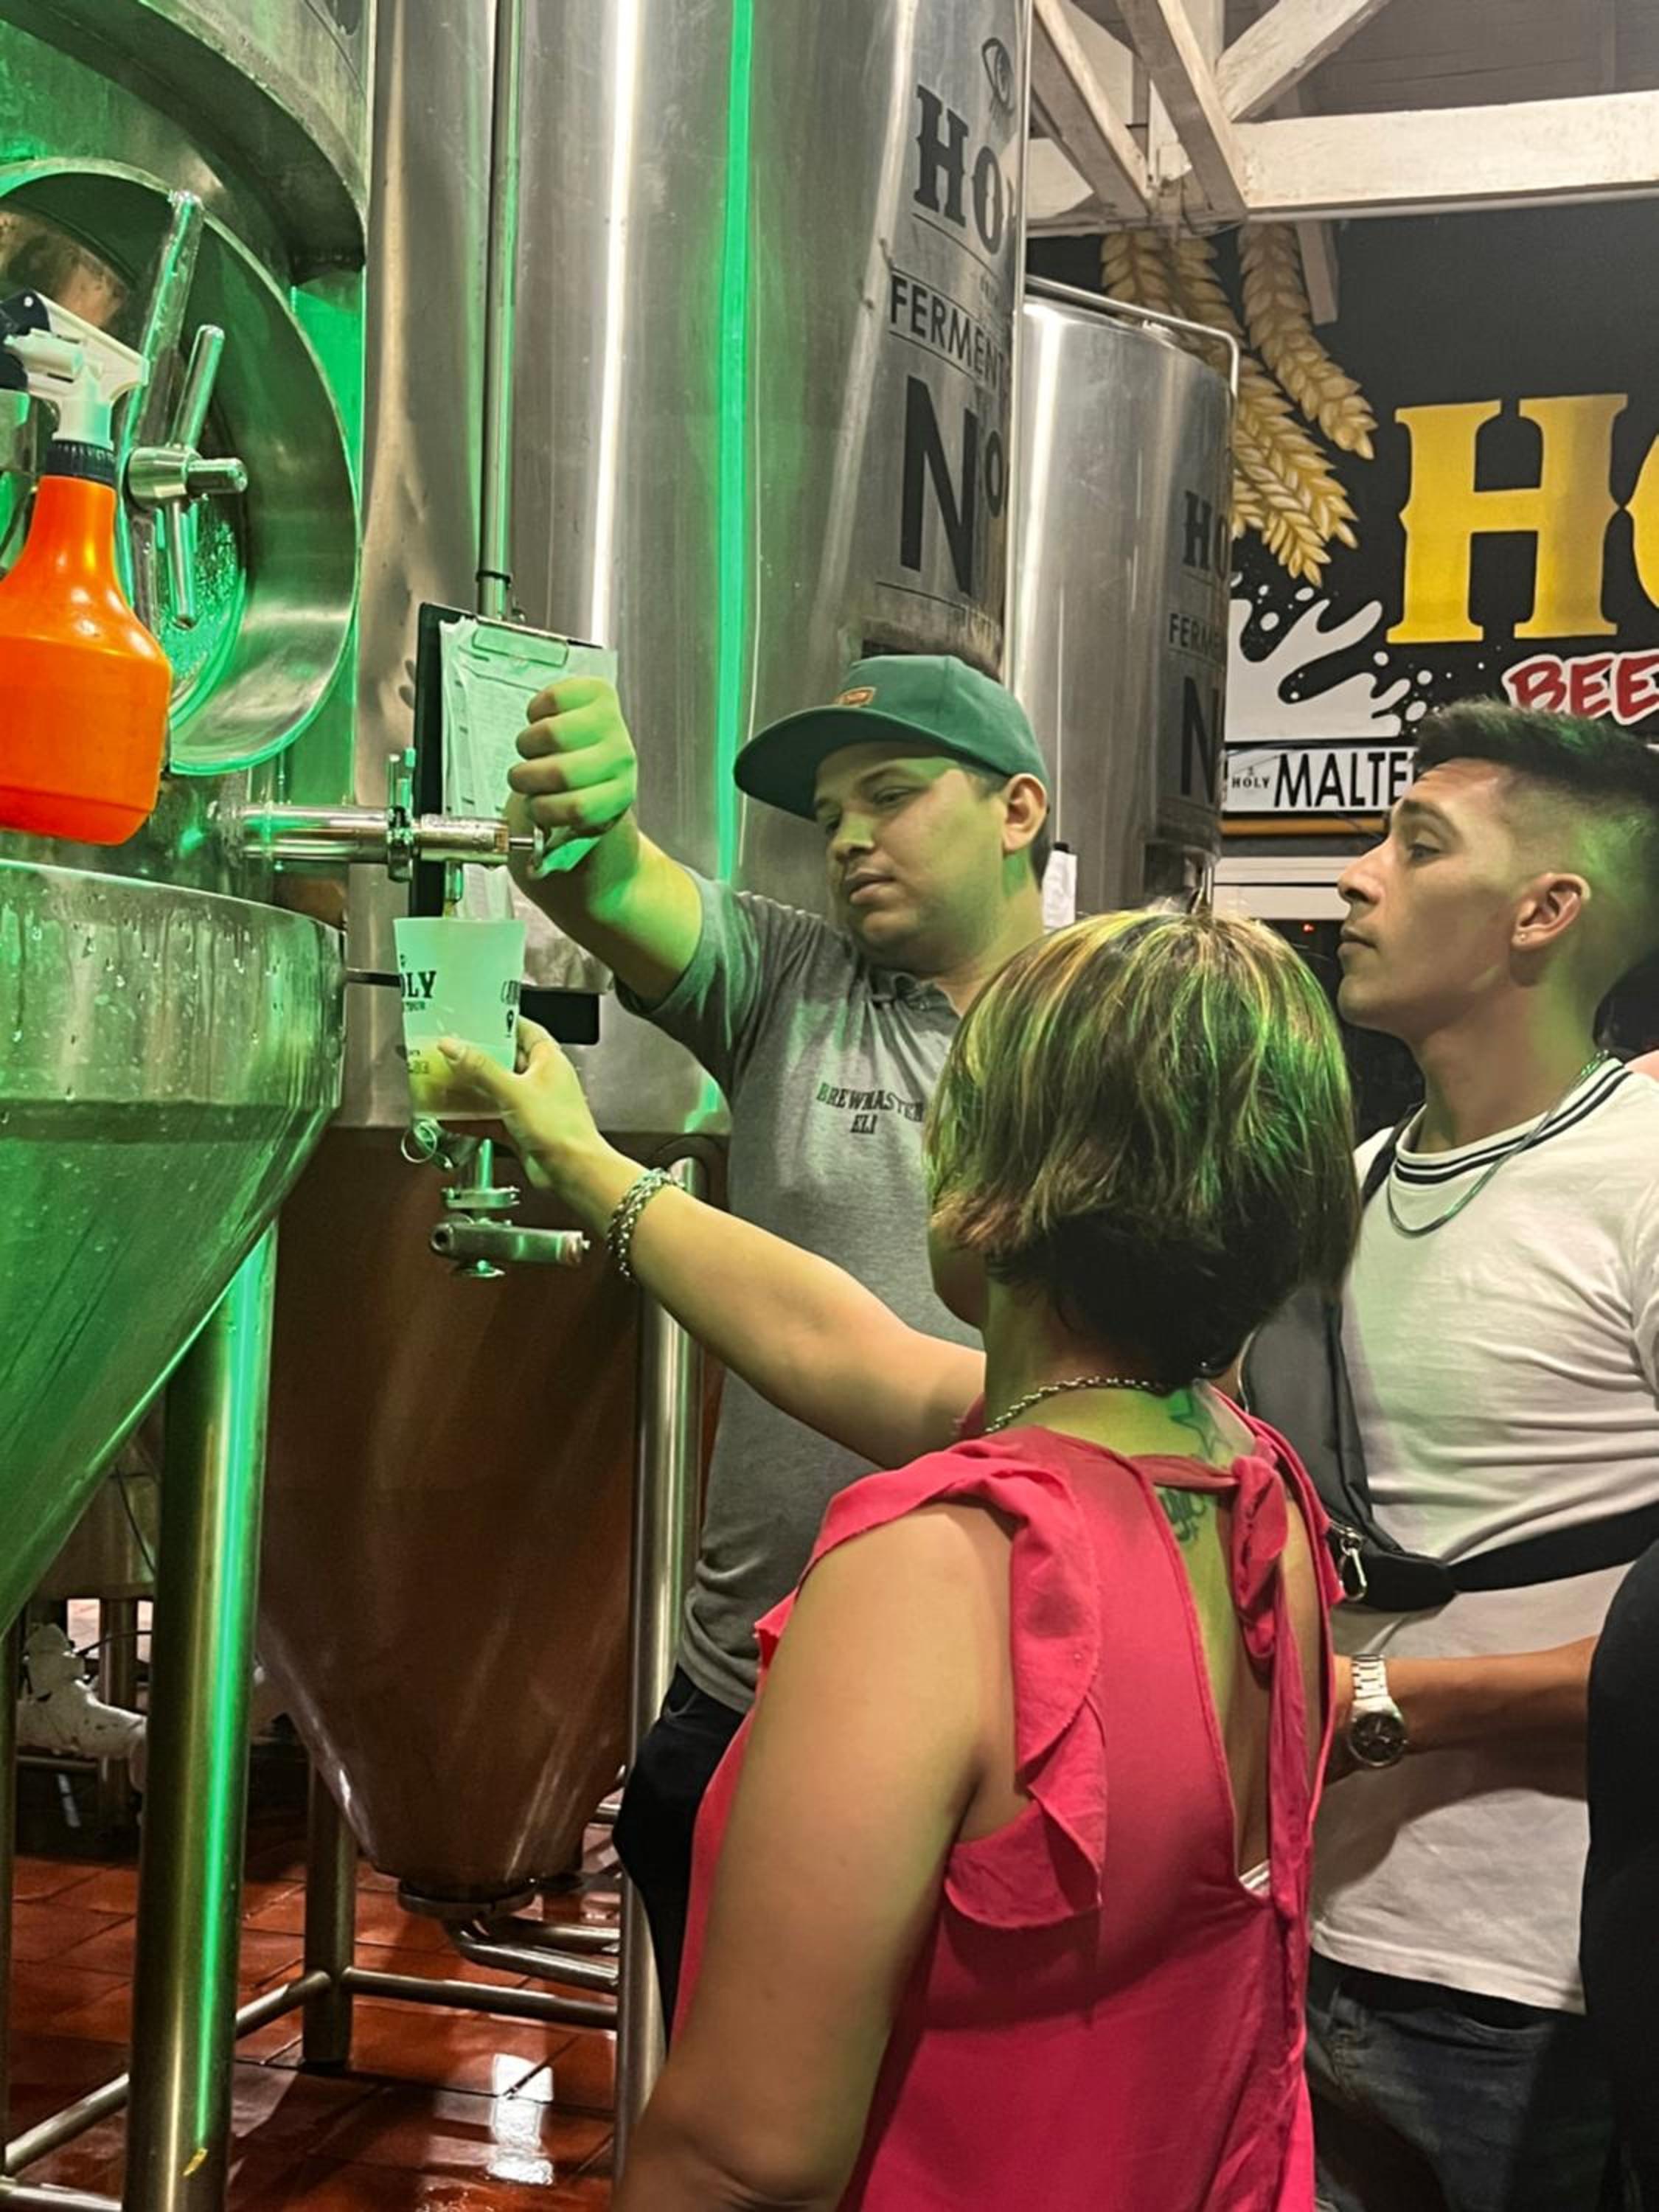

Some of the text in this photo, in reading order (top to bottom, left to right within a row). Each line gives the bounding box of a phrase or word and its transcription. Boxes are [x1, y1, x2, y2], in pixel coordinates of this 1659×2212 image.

[914, 83, 1015, 255] HO
[1386, 393, 1659, 644] H
[1231, 776, 1270, 789] HOLY
[1274, 751, 1417, 808] MALTE
